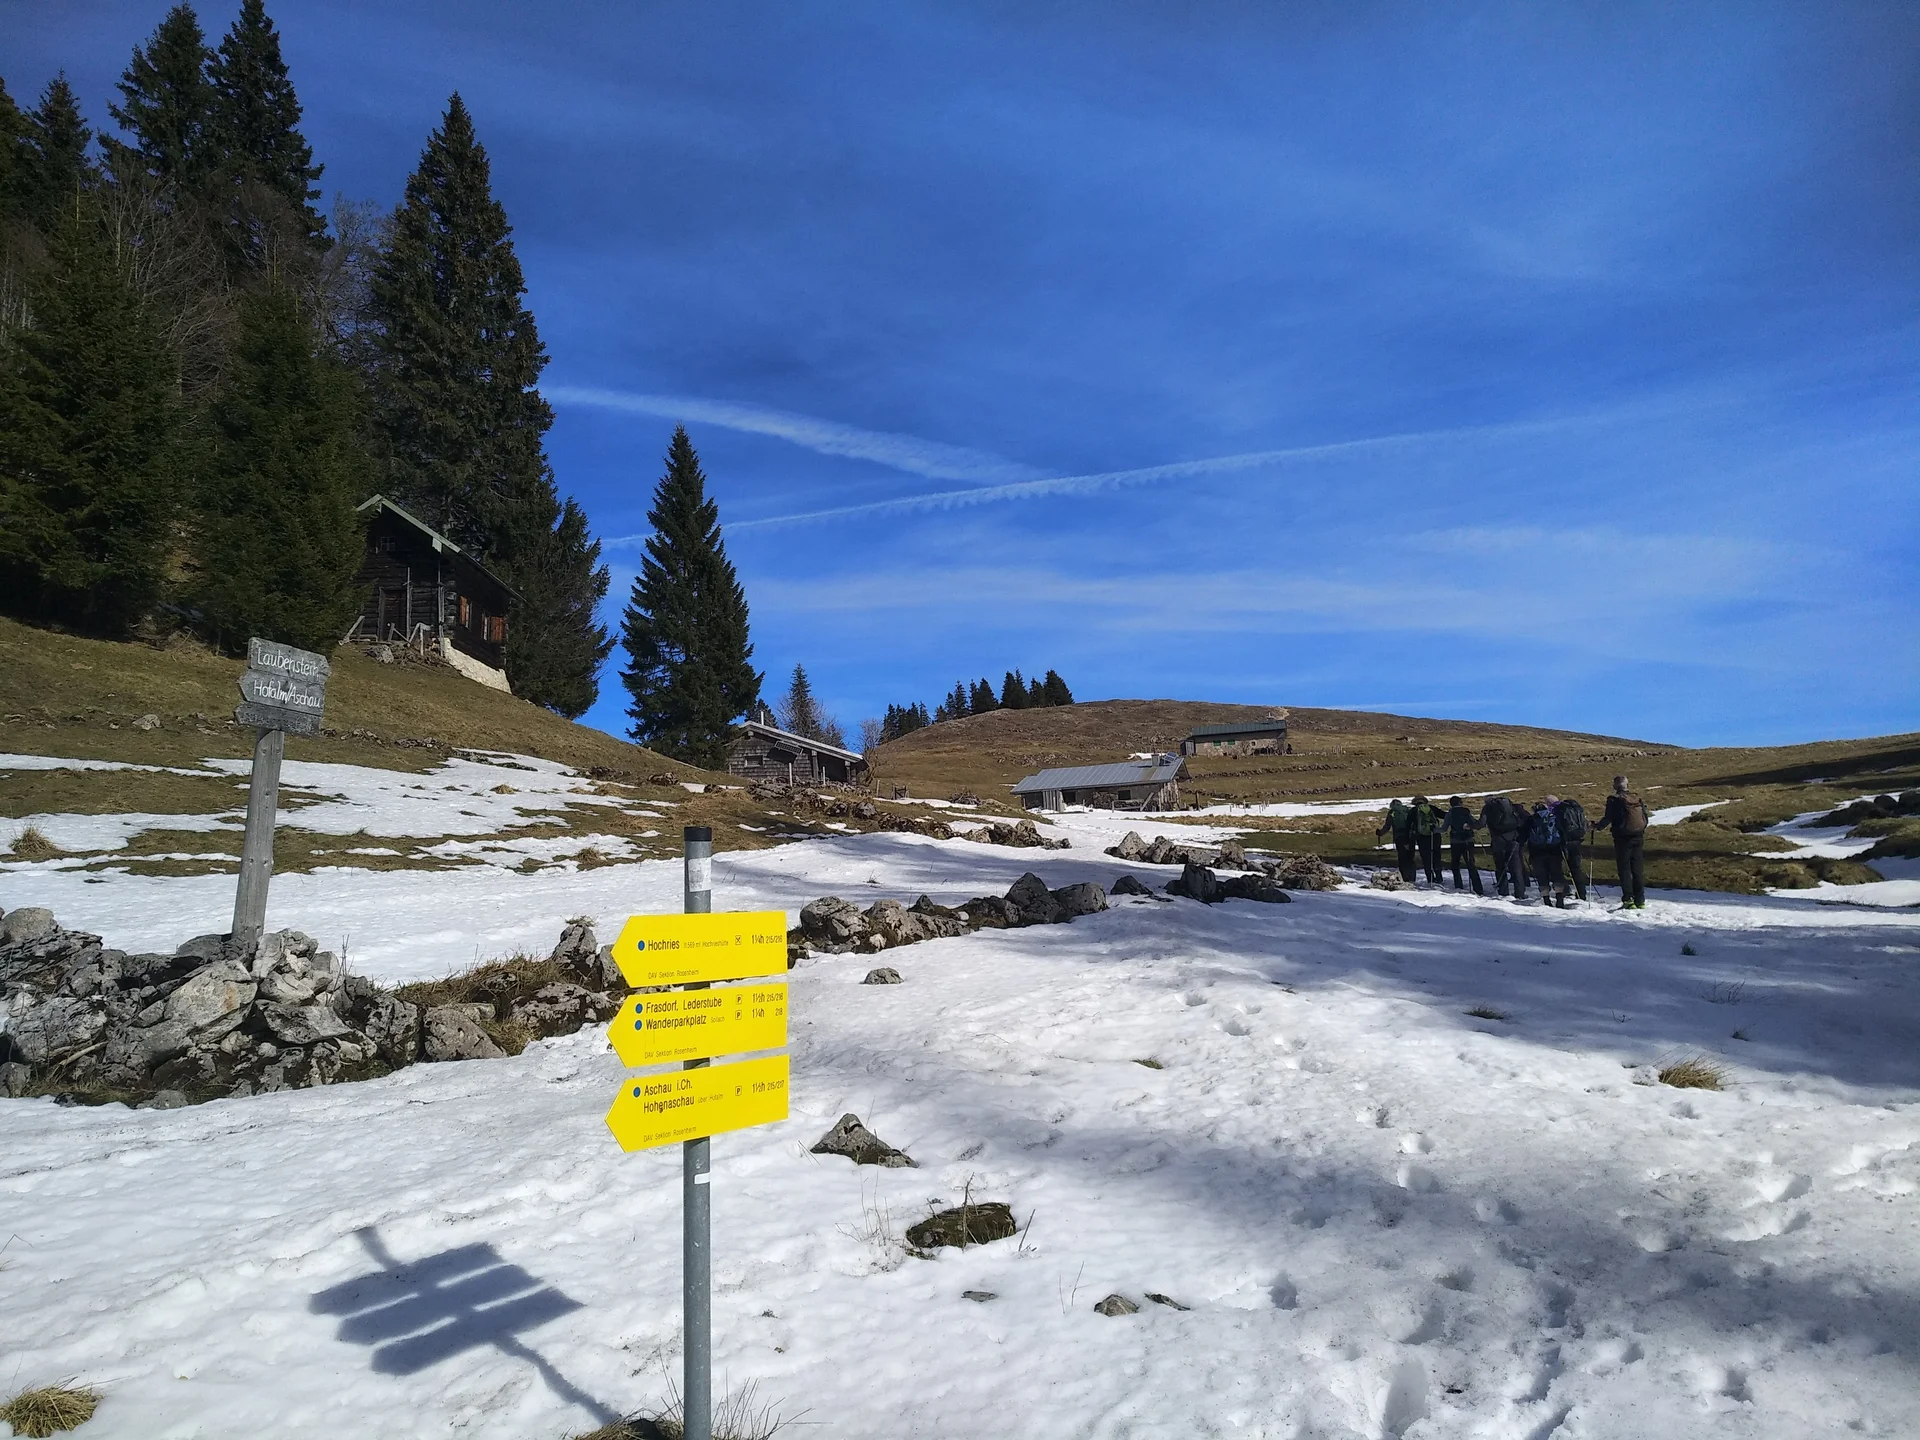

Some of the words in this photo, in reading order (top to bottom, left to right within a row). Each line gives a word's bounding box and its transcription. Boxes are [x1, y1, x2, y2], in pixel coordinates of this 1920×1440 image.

[647, 938, 680, 951] Hochries
[659, 970, 675, 978] Sektion
[676, 968, 700, 976] Rosenheim
[683, 996, 722, 1010] Lederstube
[645, 1013, 707, 1030] Wanderparkplatz
[655, 1049, 672, 1057] Sektion
[674, 1046, 698, 1055] Rosenheim
[643, 1083, 672, 1096] Aschau
[676, 1078, 693, 1091] i.Ch.
[643, 1095, 695, 1113] Hohenaschau
[654, 1131, 672, 1140] Sektion
[673, 1126, 697, 1136] Rosenheim
